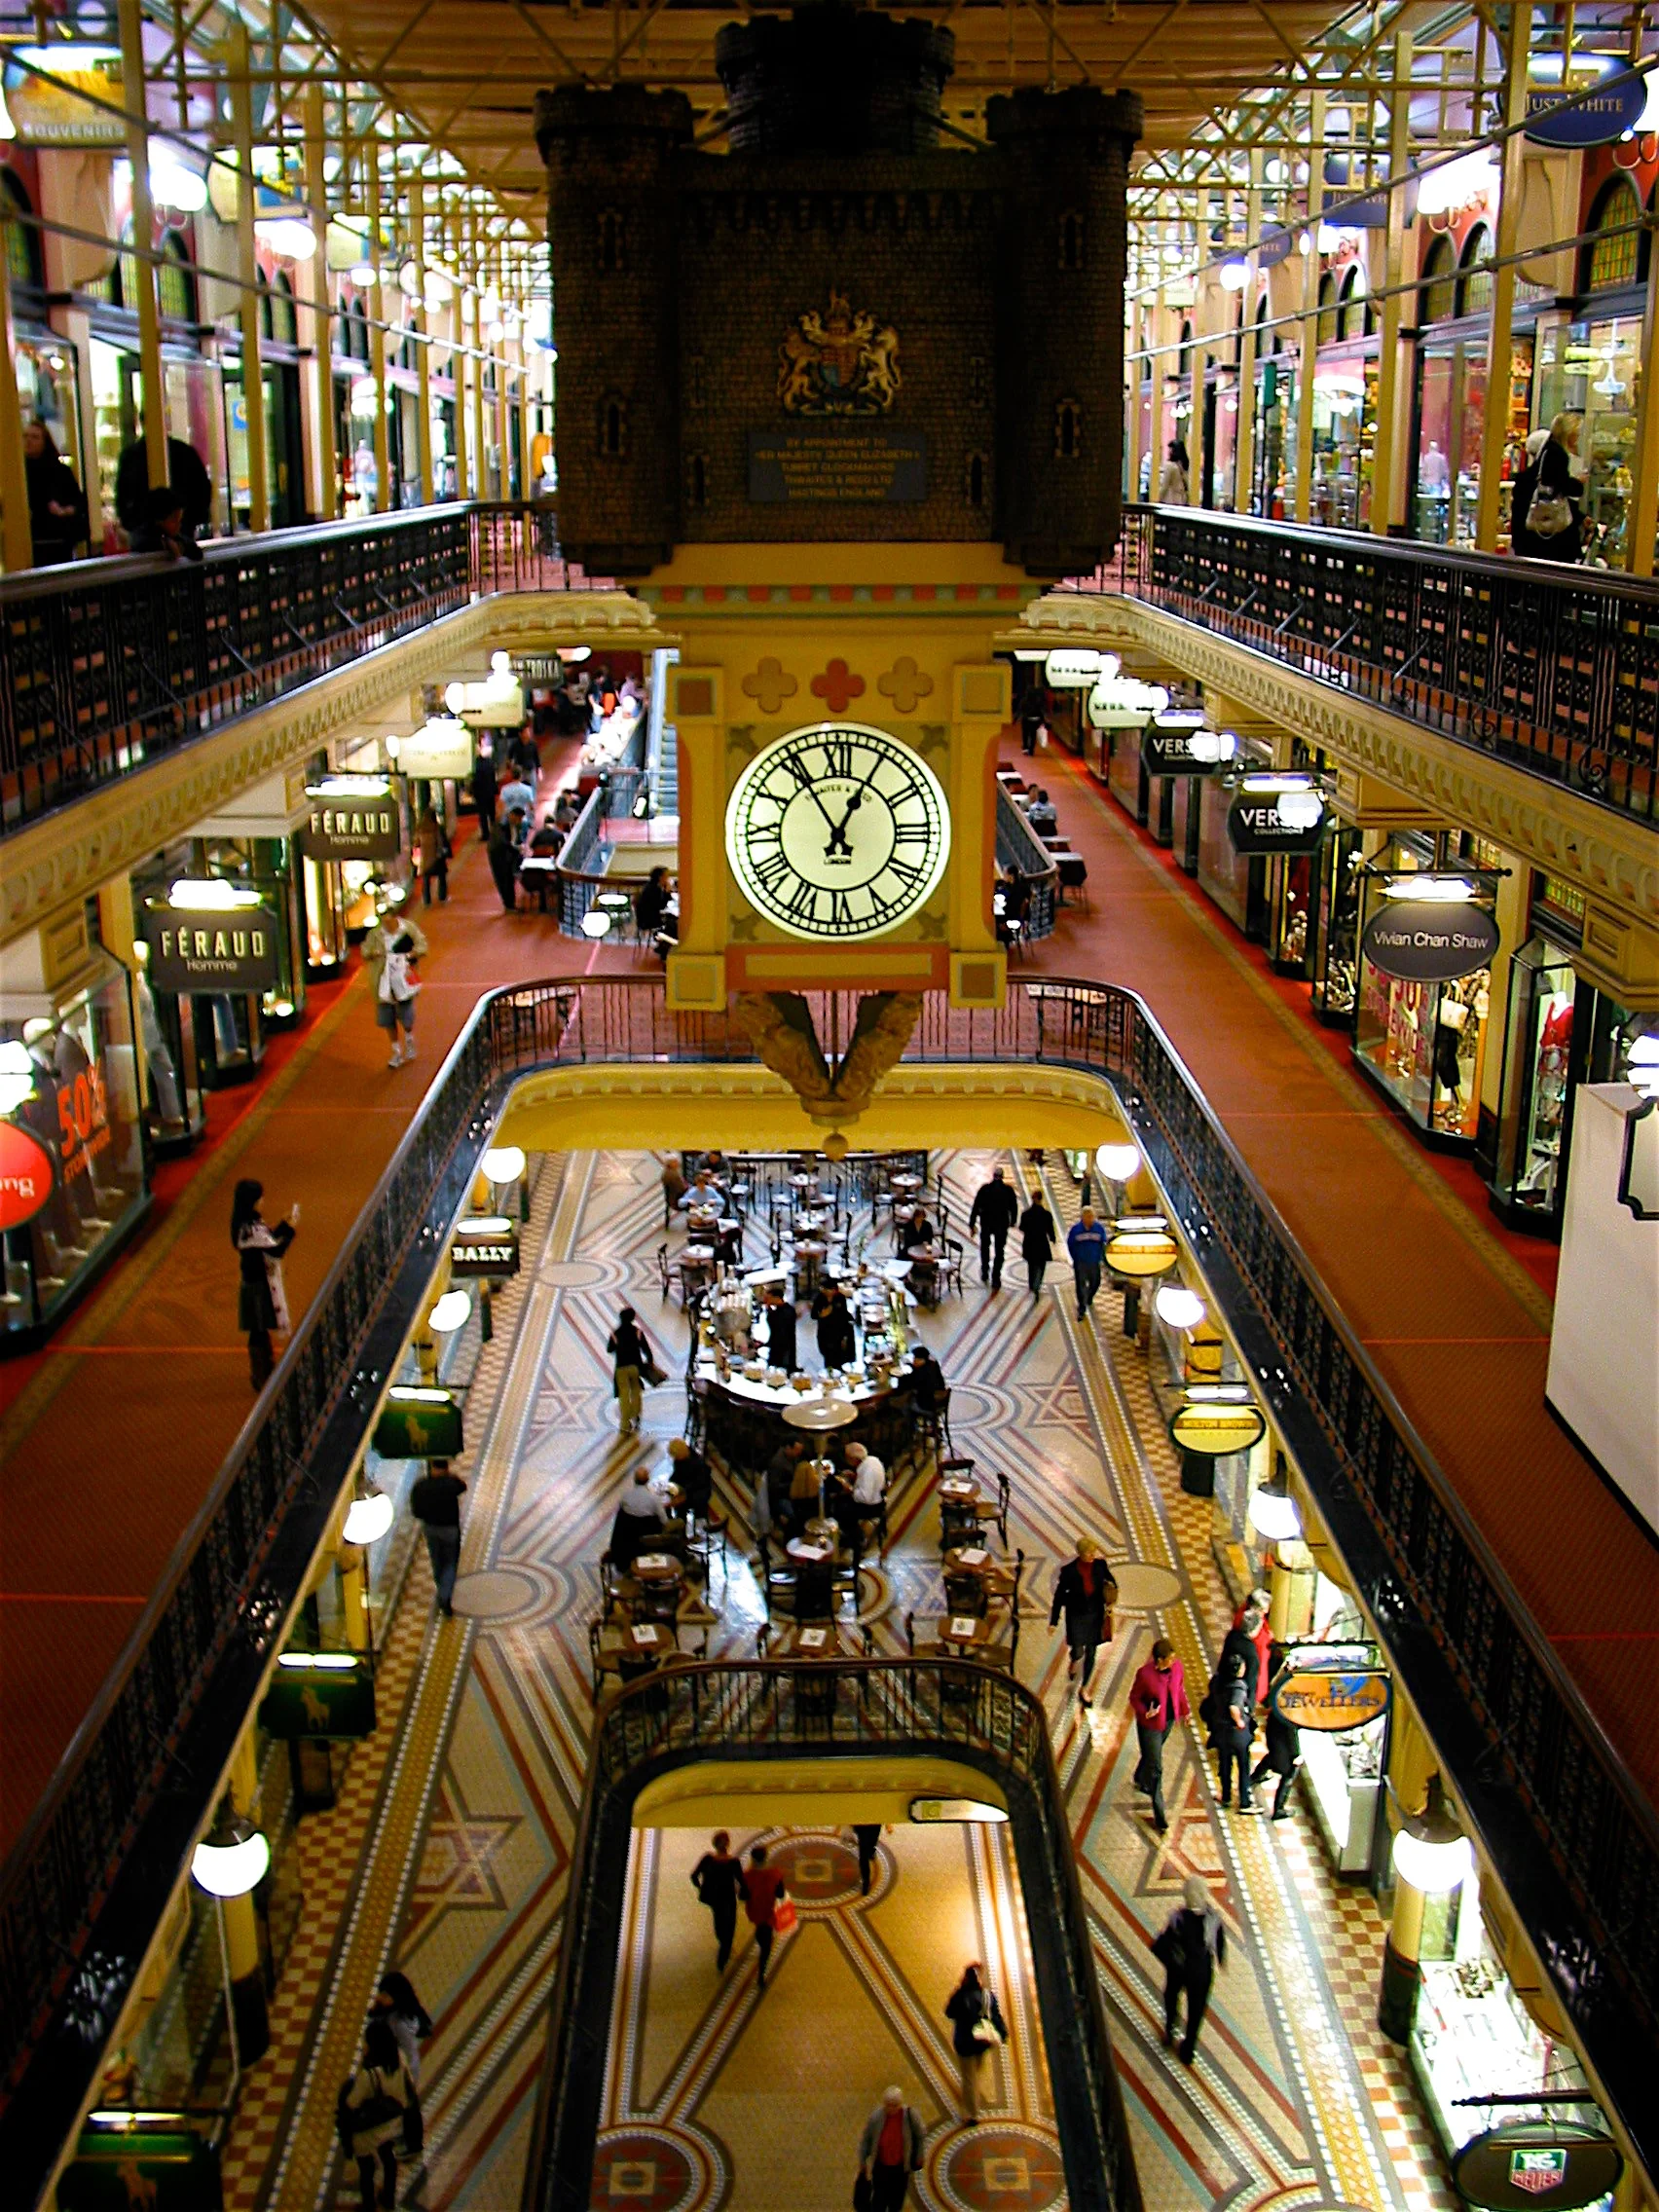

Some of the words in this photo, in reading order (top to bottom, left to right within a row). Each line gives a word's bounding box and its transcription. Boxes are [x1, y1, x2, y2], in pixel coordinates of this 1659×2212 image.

[311, 809, 389, 834] FÉRAUD
[161, 926, 264, 958] FÉRAUD
[1374, 931, 1412, 946] Vivian
[1414, 931, 1450, 947] Chan
[1452, 933, 1489, 949] Shaw
[186, 959, 238, 972] Homme
[0, 1176, 35, 1198] ng
[452, 1246, 513, 1262] BALLY
[1279, 1695, 1380, 1709] JEWELLERS
